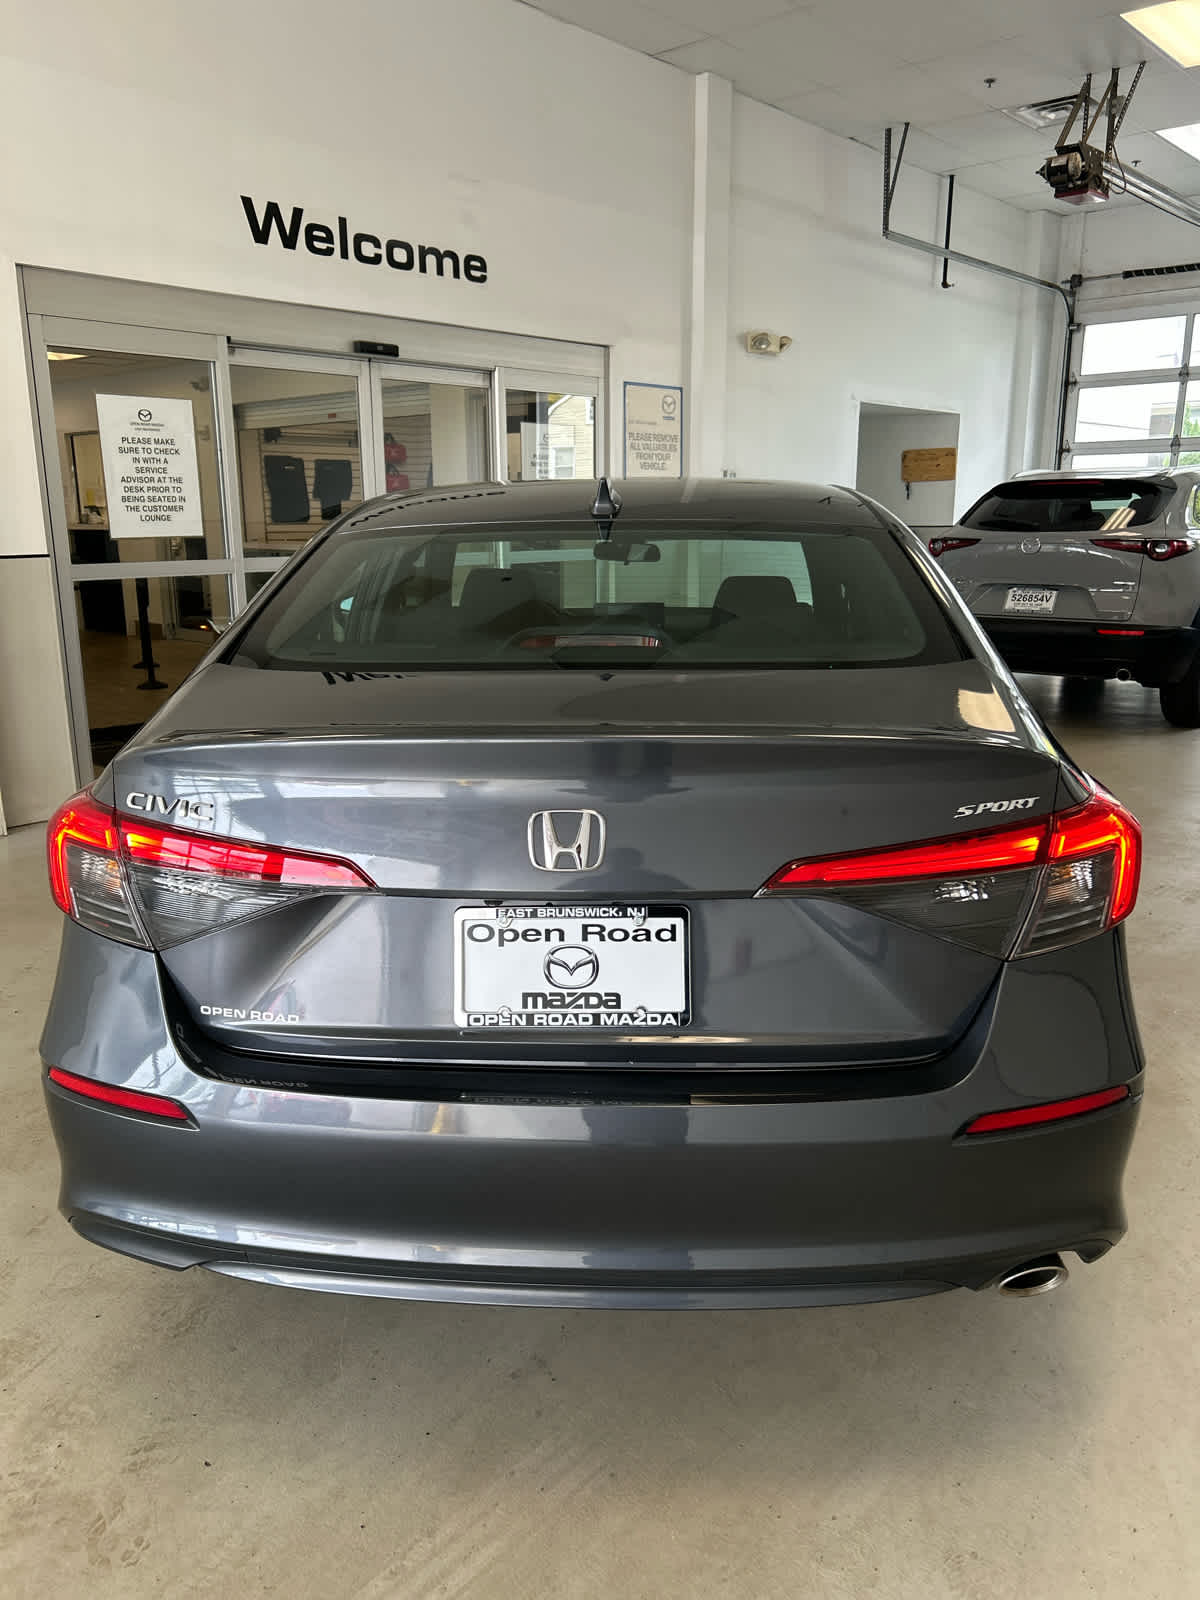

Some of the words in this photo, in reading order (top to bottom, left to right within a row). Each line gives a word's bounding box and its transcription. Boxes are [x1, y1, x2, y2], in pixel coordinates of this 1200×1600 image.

[240, 195, 488, 284] Welcome
[121, 436, 152, 445] PLEASE
[153, 438, 176, 446] MAKE
[118, 446, 140, 455] SURE
[142, 447, 153, 455] TO
[153, 447, 181, 455] CHECK
[142, 457, 161, 465] WITH
[163, 457, 169, 465] A
[135, 466, 168, 474] SERVICE
[120, 476, 155, 484] ADVISOR
[156, 476, 167, 484] AT
[168, 476, 183, 484] THE
[123, 486, 145, 494] DESK
[121, 495, 146, 503] BEING
[146, 495, 177, 503] SEATED
[140, 514, 172, 522] LOUNGE
[1011, 593, 1052, 603] 526854V
[126, 792, 214, 821] CIVIC
[953, 796, 1041, 819] SPORT
[497, 908, 532, 919] EAST
[627, 906, 646, 917] NJ
[466, 923, 566, 947] Open
[581, 923, 677, 943] Road
[200, 1005, 246, 1019] OPEN
[250, 1010, 299, 1024] ROAD
[468, 1013, 527, 1027] OPEN
[533, 1013, 594, 1026] ROAD
[600, 1012, 678, 1026] MAZDA
